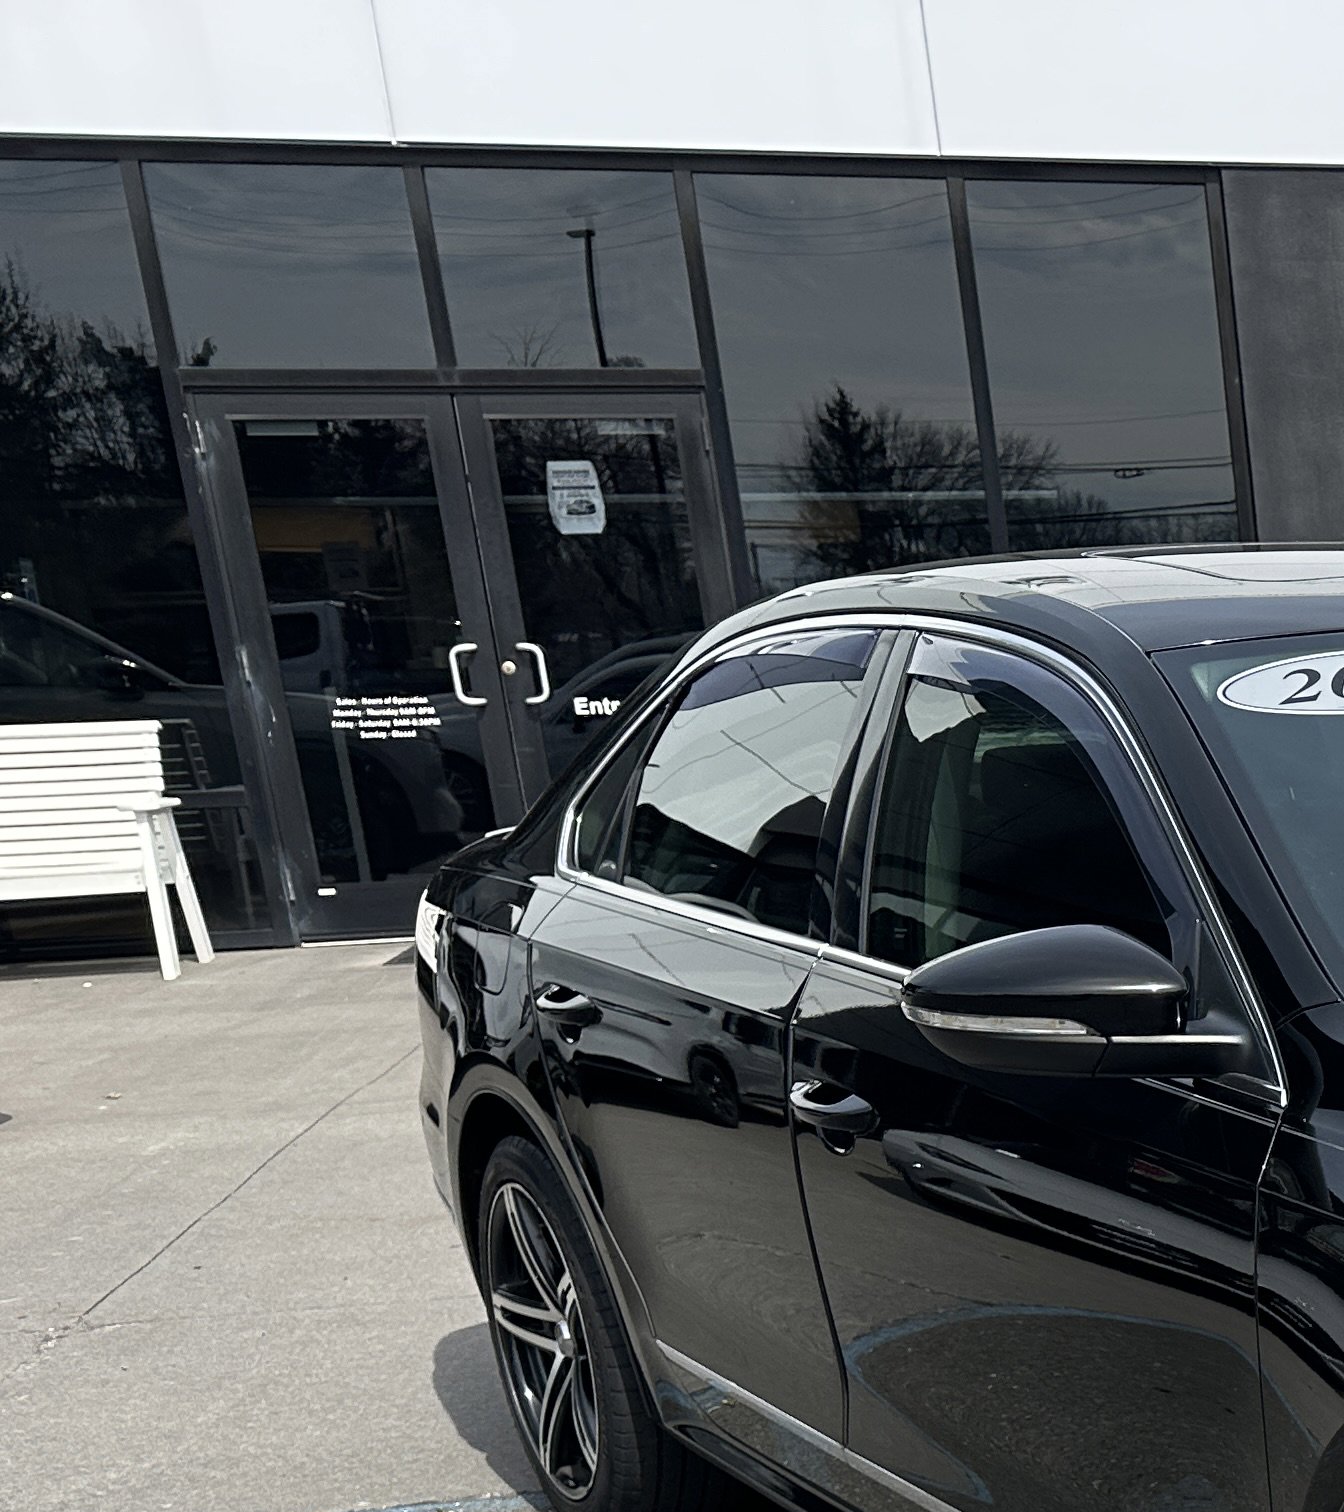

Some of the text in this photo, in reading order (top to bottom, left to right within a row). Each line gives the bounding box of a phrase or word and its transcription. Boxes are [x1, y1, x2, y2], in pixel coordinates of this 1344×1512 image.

[392, 696, 428, 705] Operation
[573, 696, 621, 716] Entr
[333, 708, 361, 717] Monday
[359, 719, 391, 728] Saturday
[360, 730, 387, 739] Sunday
